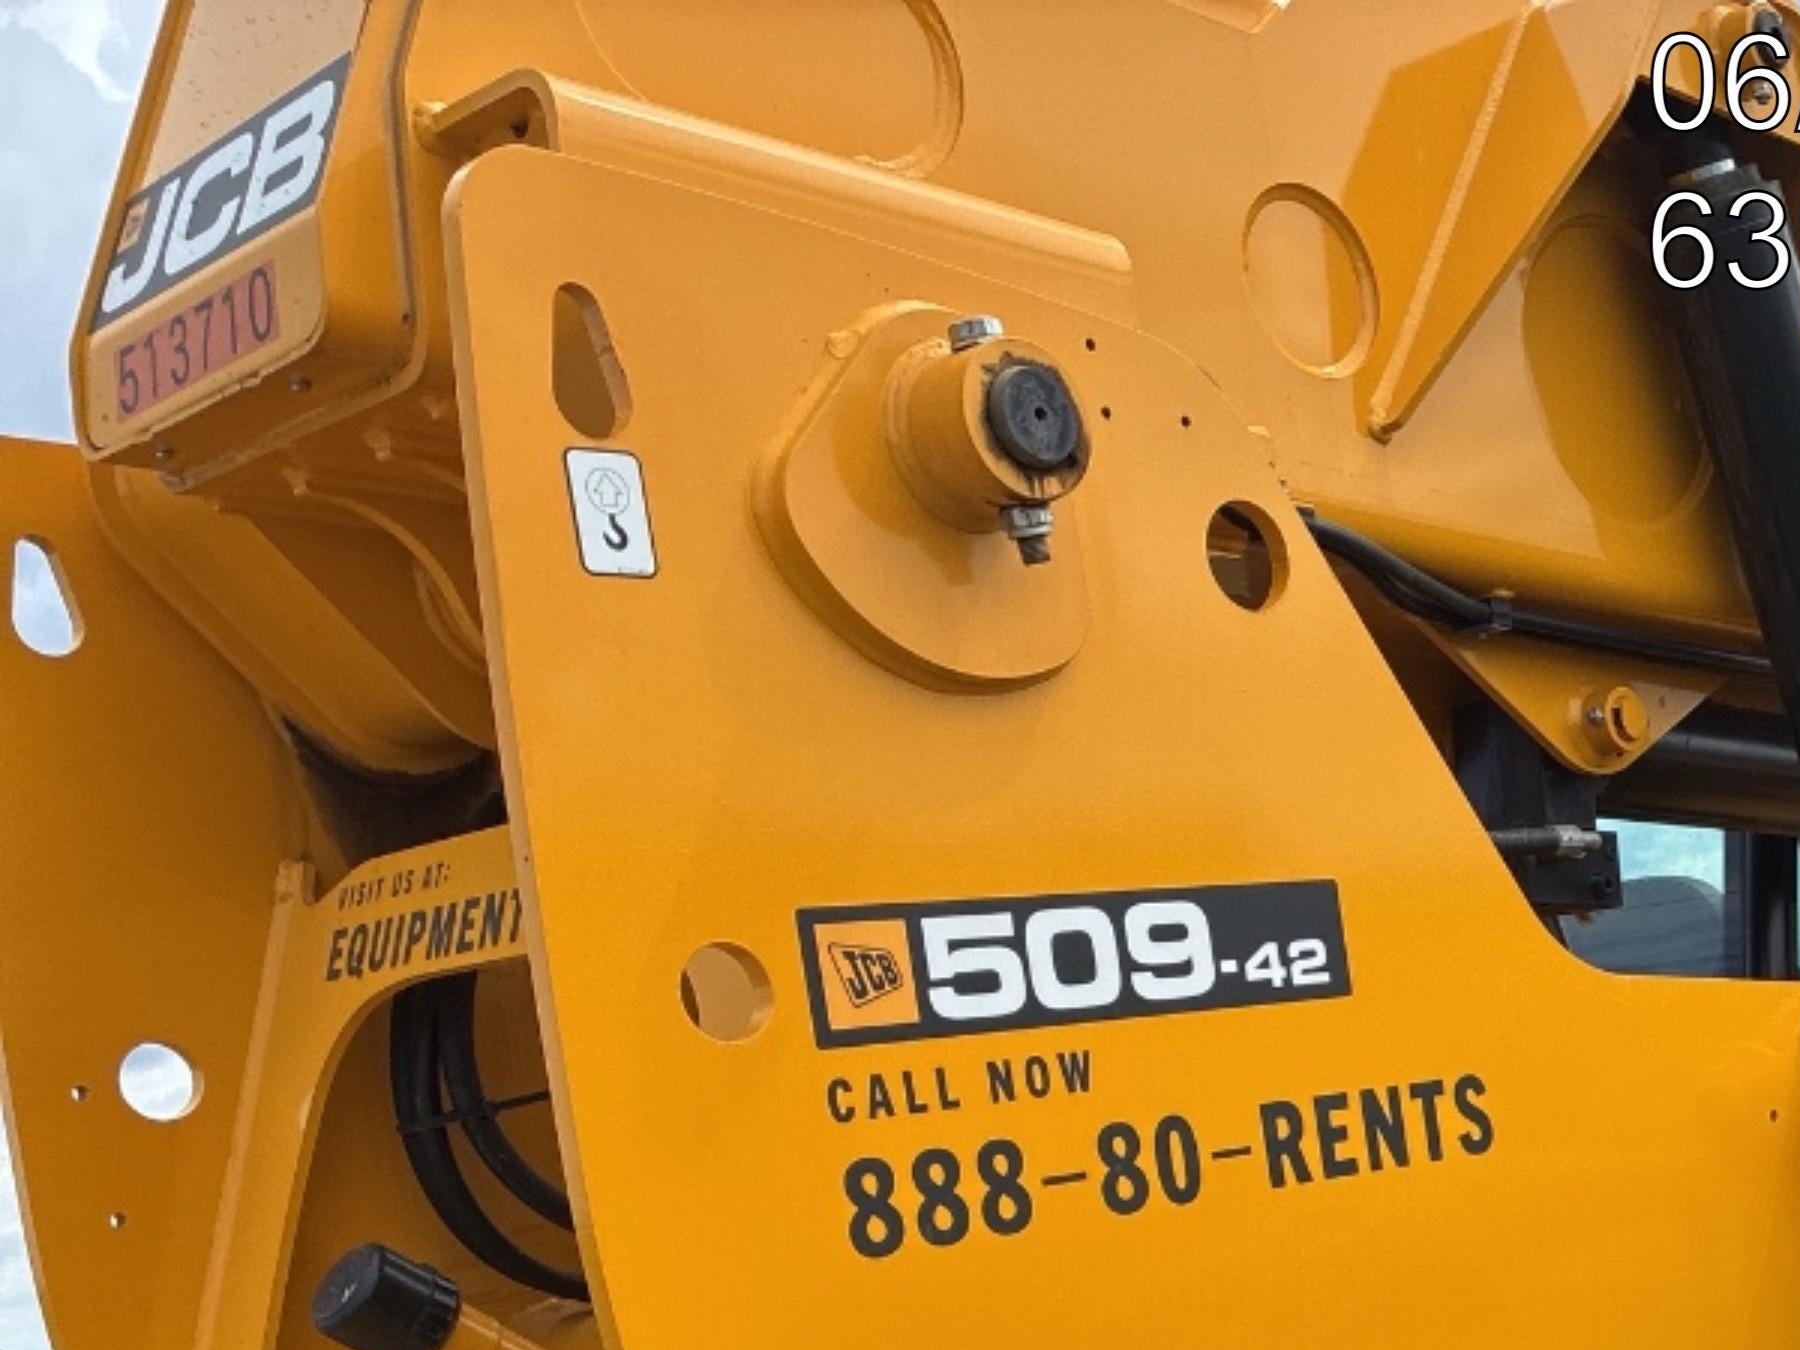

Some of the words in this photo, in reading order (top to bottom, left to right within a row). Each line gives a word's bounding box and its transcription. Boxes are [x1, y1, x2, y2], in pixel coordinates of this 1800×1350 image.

[101, 79, 336, 314] JCB
[116, 264, 275, 416] 513710
[338, 877, 385, 911] VISIT
[392, 869, 415, 898] US
[842, 950, 899, 999] JCB
[920, 900, 1332, 1021] 509-42
[826, 1066, 961, 1123] CALL
[985, 1050, 1093, 1103] NOW
[842, 1073, 1496, 1260] 888-80-RENTS
